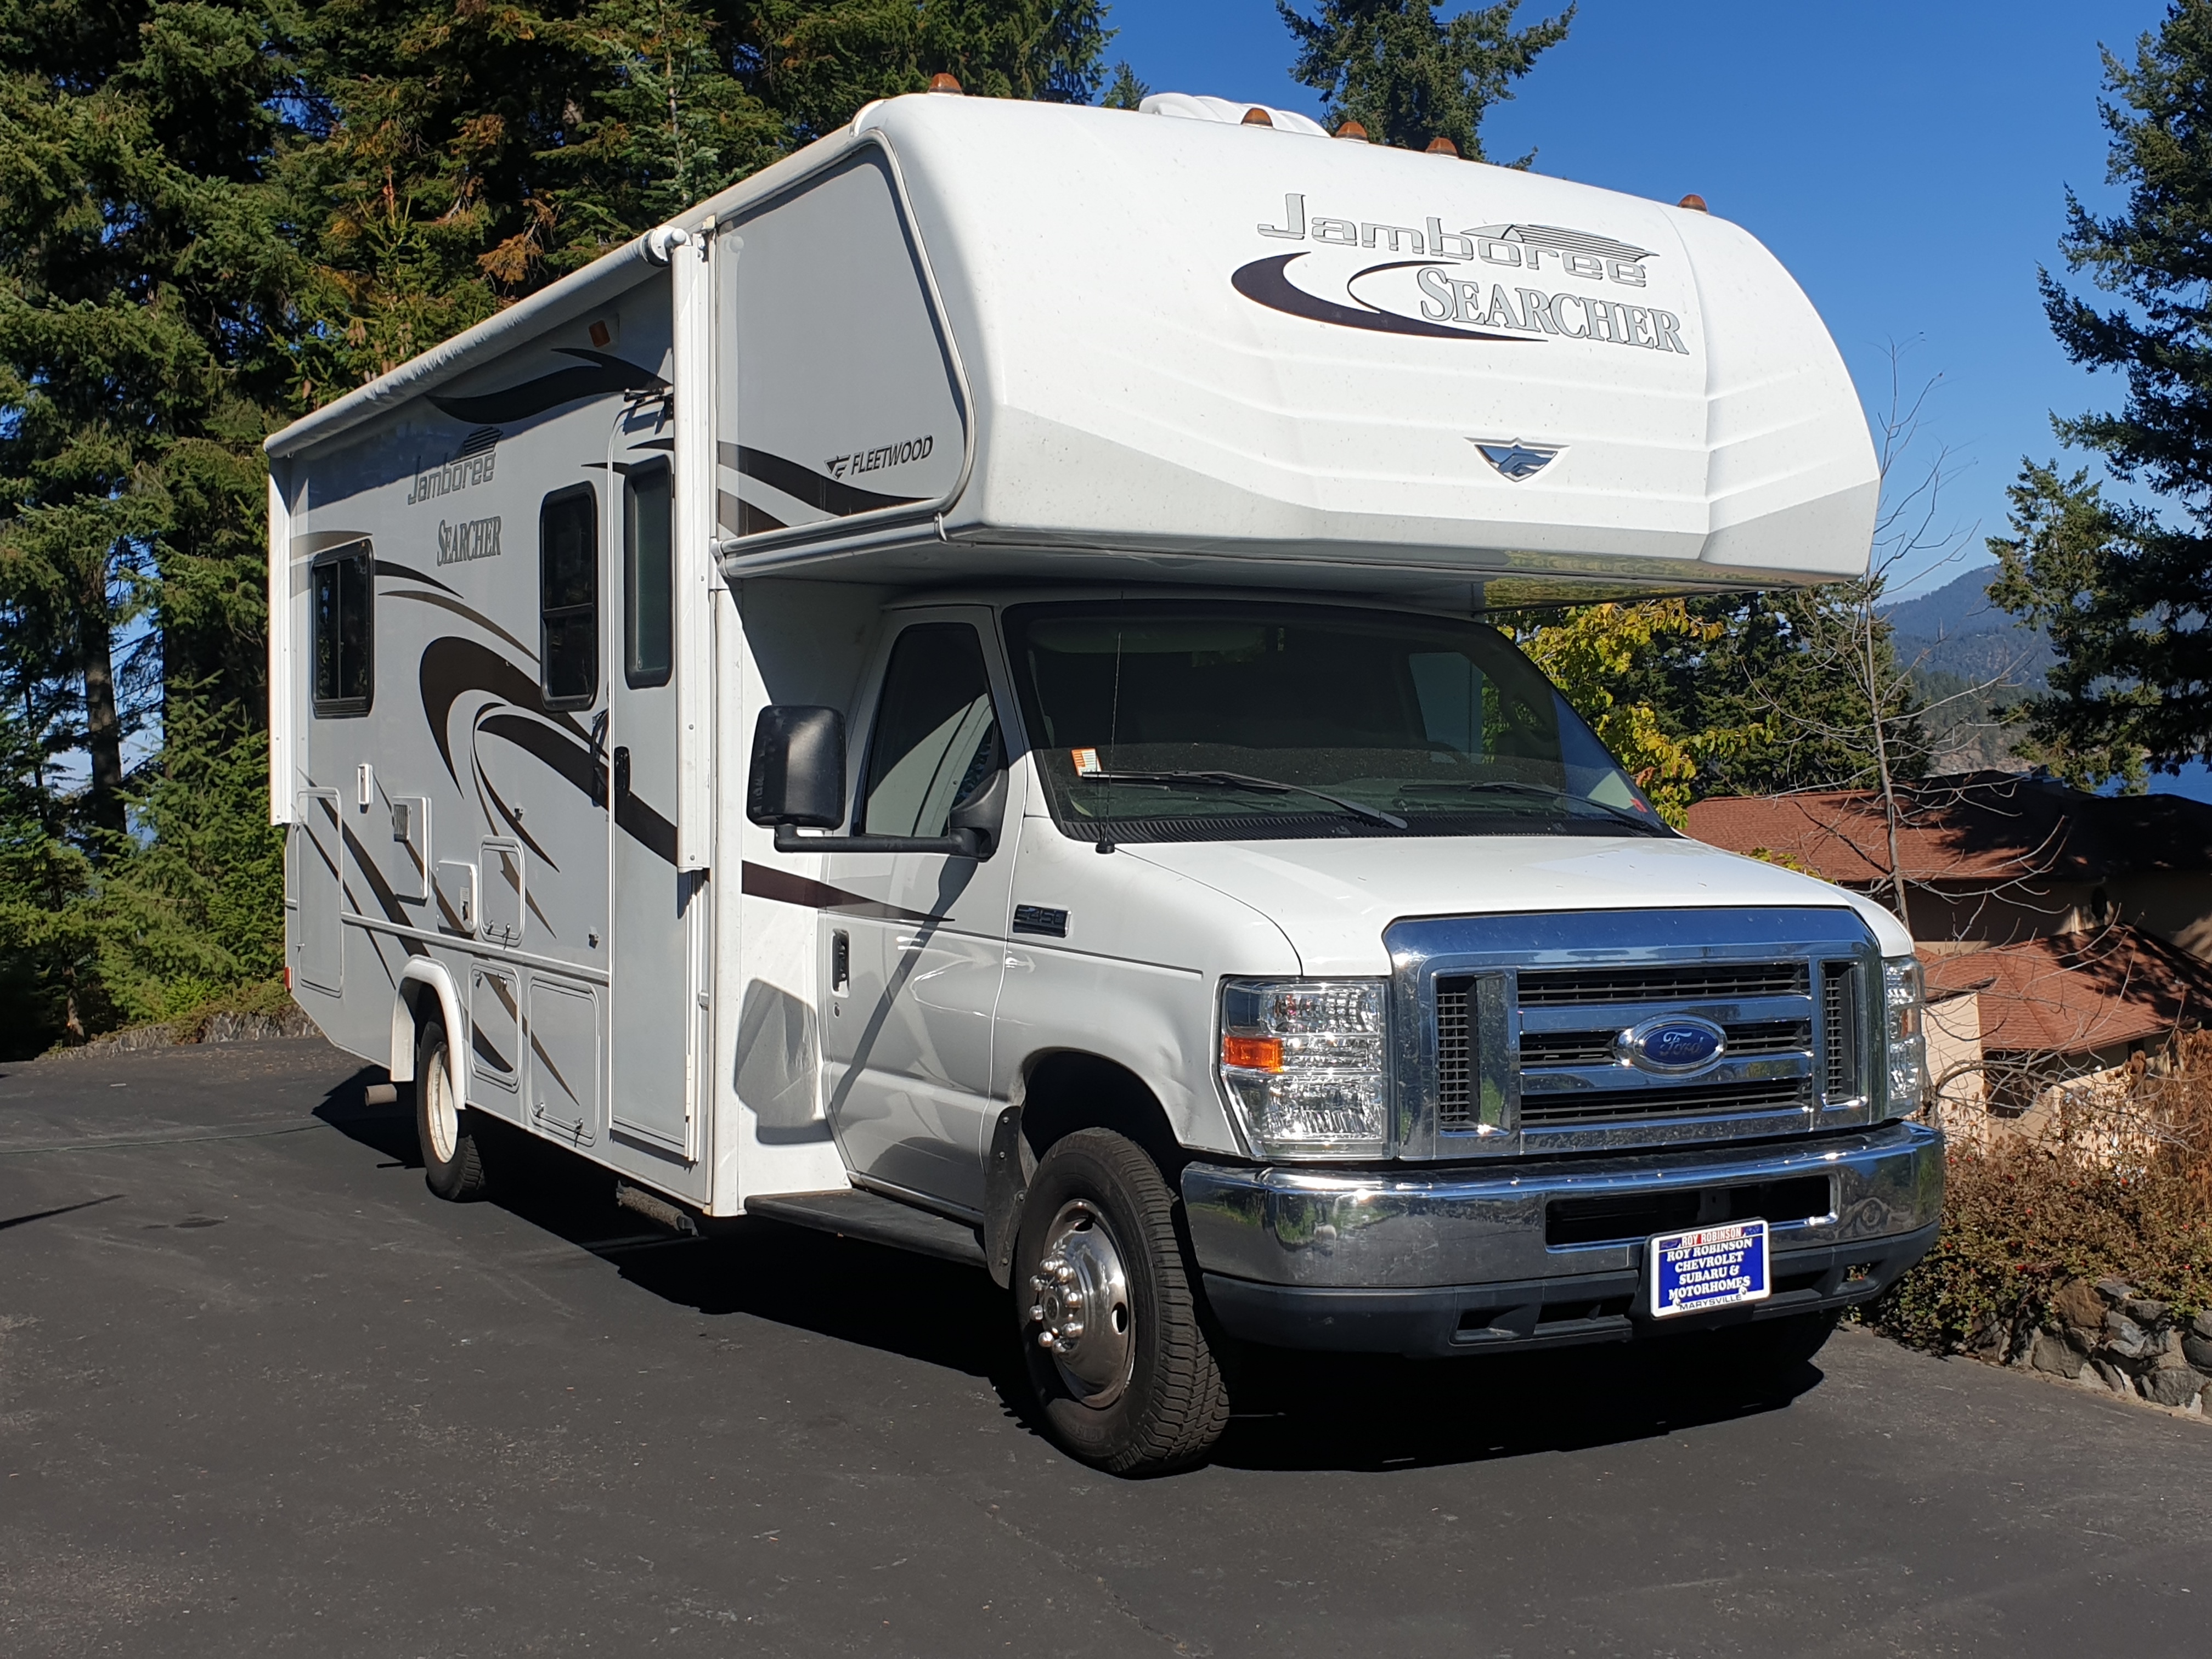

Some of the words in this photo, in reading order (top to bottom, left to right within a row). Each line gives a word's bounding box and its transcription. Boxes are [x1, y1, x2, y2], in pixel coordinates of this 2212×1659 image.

[1257, 193, 1647, 287] Jamboree
[1417, 267, 1690, 354] SEARCHER
[851, 435, 933, 476] FLEETWOOD
[408, 452, 496, 505] Jamboree
[437, 516, 501, 567] SEARCHER
[1659, 1031, 1704, 1057] Ford
[1681, 1234, 1699, 1247] ROY
[1701, 1227, 1742, 1244] ROBINSON
[1667, 1248, 1692, 1262] ROY
[1693, 1238, 1753, 1257] ROBINSON
[1675, 1251, 1744, 1273] CHEVROLET
[1679, 1266, 1728, 1285] SUBARU
[1729, 1265, 1740, 1276] &
[1668, 1276, 1751, 1300] MOTORHOMES
[1679, 1294, 1742, 1311] MARYSVILLE
